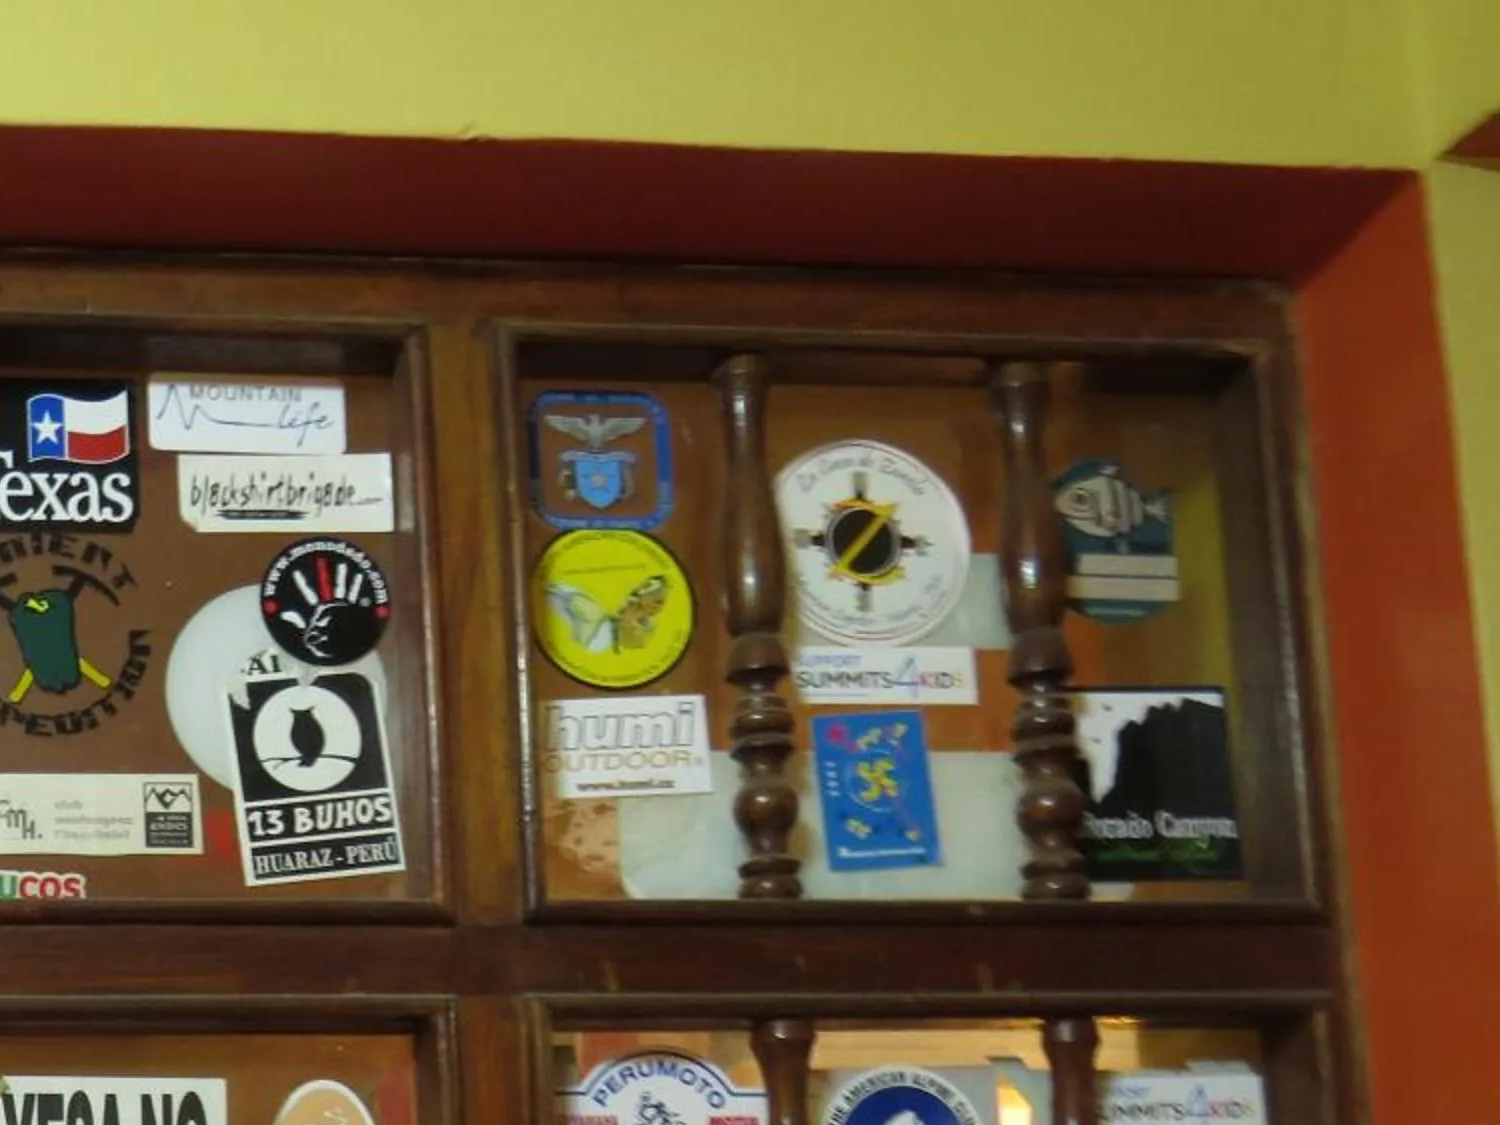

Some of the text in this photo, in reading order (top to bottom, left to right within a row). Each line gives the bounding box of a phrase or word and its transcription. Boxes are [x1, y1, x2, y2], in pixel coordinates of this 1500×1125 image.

[189, 383, 301, 402] MOUNTAIN
[248, 795, 393, 837] 13 BUHOS
[254, 847, 334, 875] HUARAZ
[592, 1059, 726, 1109] PERUMOTO
